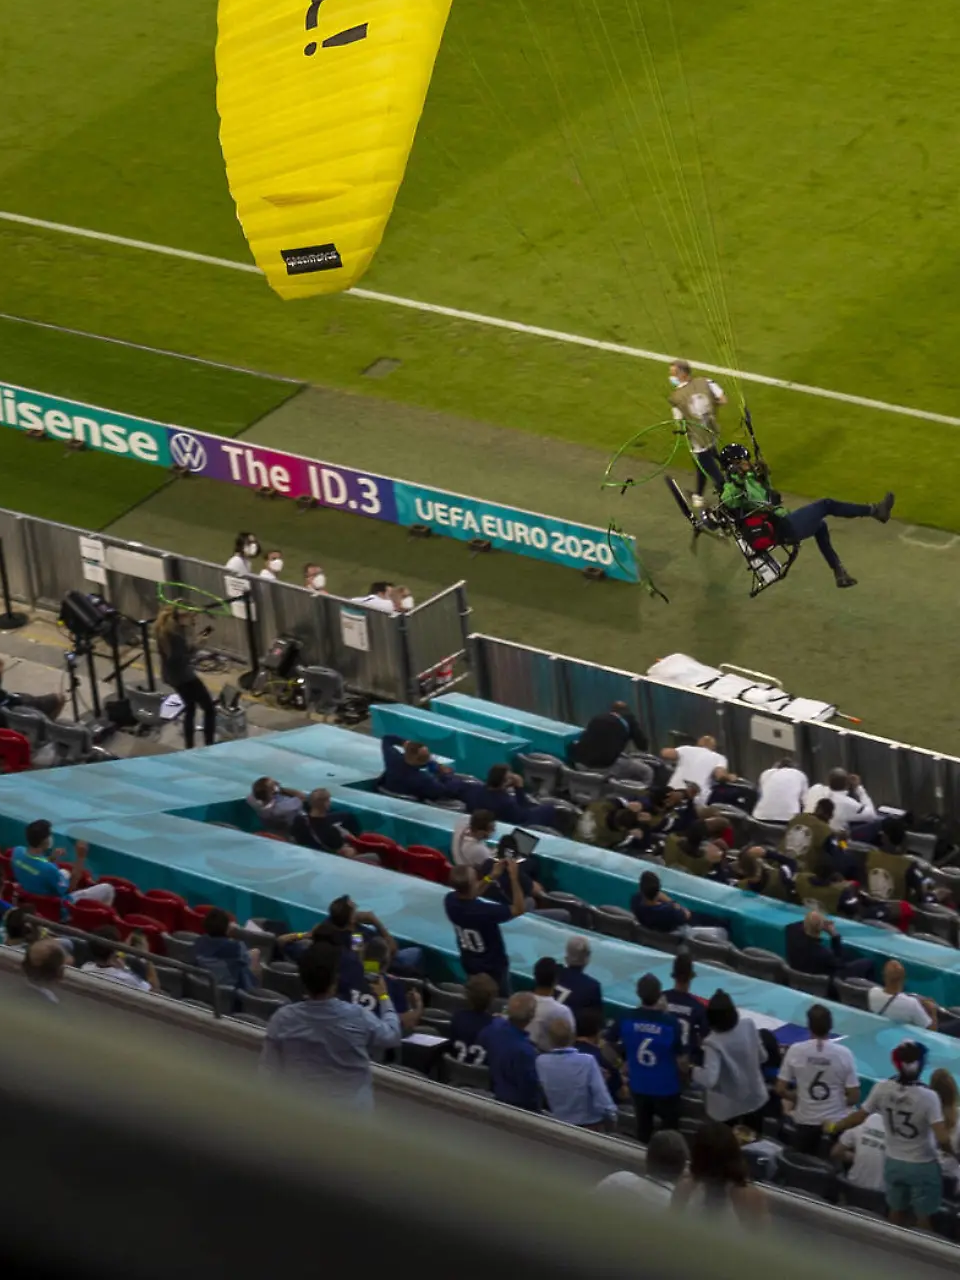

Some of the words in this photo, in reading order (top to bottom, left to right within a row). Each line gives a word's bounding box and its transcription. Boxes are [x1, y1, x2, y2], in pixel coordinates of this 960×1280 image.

[220, 444, 291, 493] The
[308, 465, 382, 516] ID.3
[414, 497, 481, 534] UEFA
[481, 515, 548, 550] EURO
[551, 532, 616, 566] 2020
[637, 1037, 658, 1068] 6
[809, 1070, 830, 1102] 6
[885, 1106, 920, 1140] 13
